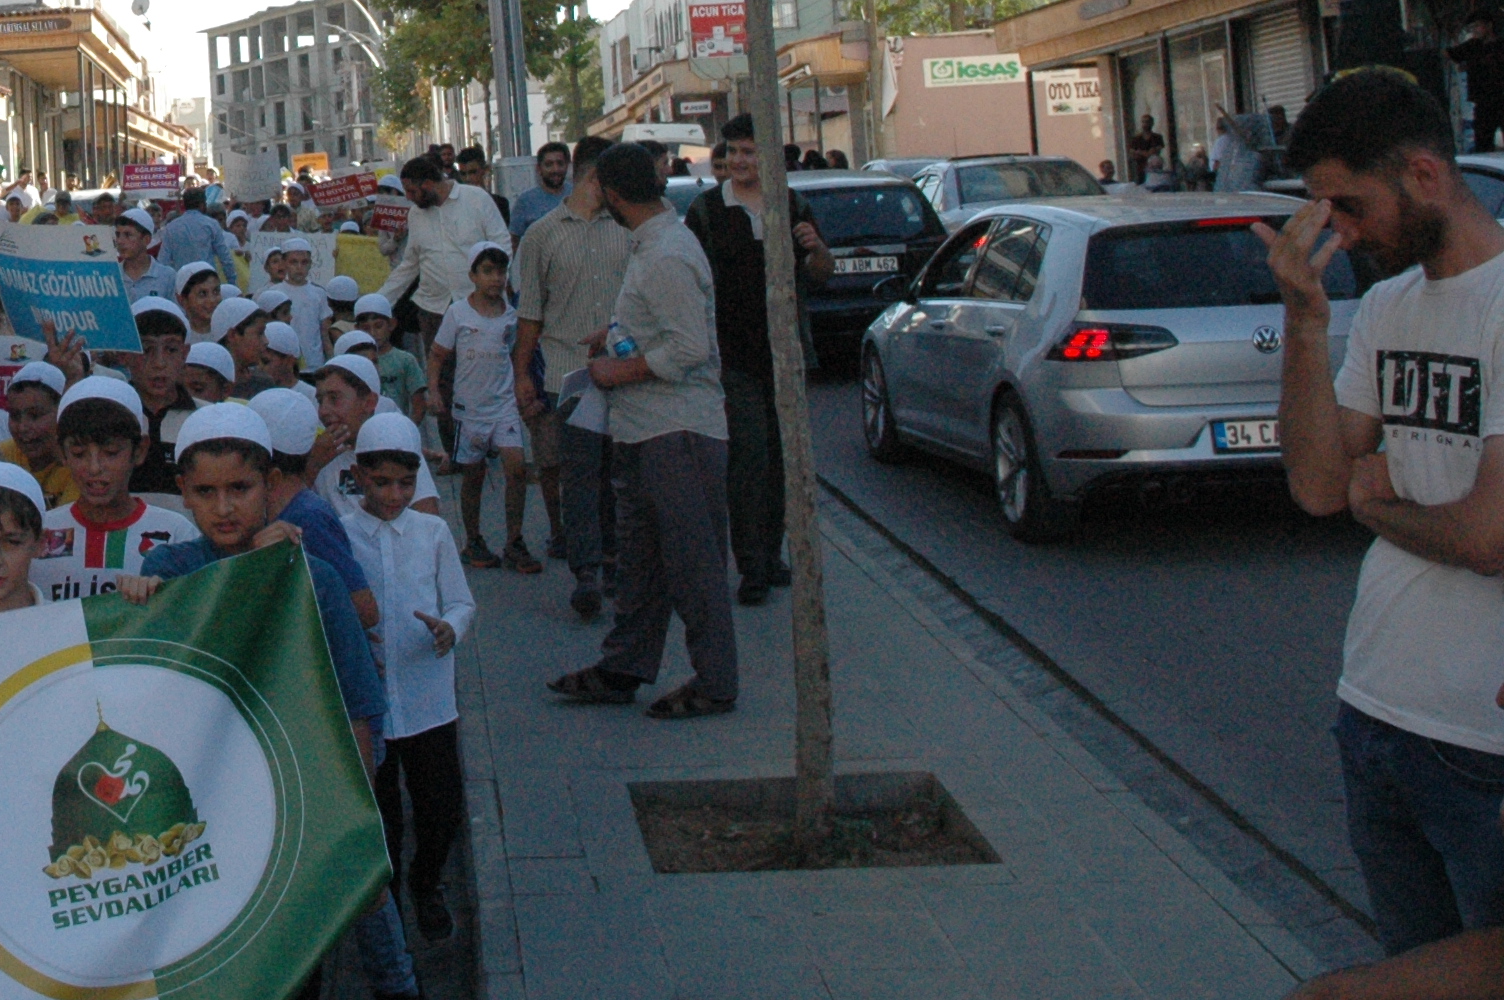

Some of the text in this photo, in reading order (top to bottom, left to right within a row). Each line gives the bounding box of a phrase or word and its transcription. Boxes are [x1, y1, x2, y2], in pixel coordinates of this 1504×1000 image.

[692, 4, 746, 18] ACUN TİCA
[1048, 81, 1101, 100] OTO YIKA
[877, 258, 896, 270] 462
[38, 270, 119, 298] GÖZÜMÜN
[1227, 423, 1253, 446] 34
[48, 843, 214, 908] PEYGAMBER
[52, 863, 220, 930] SEVDALILARI
